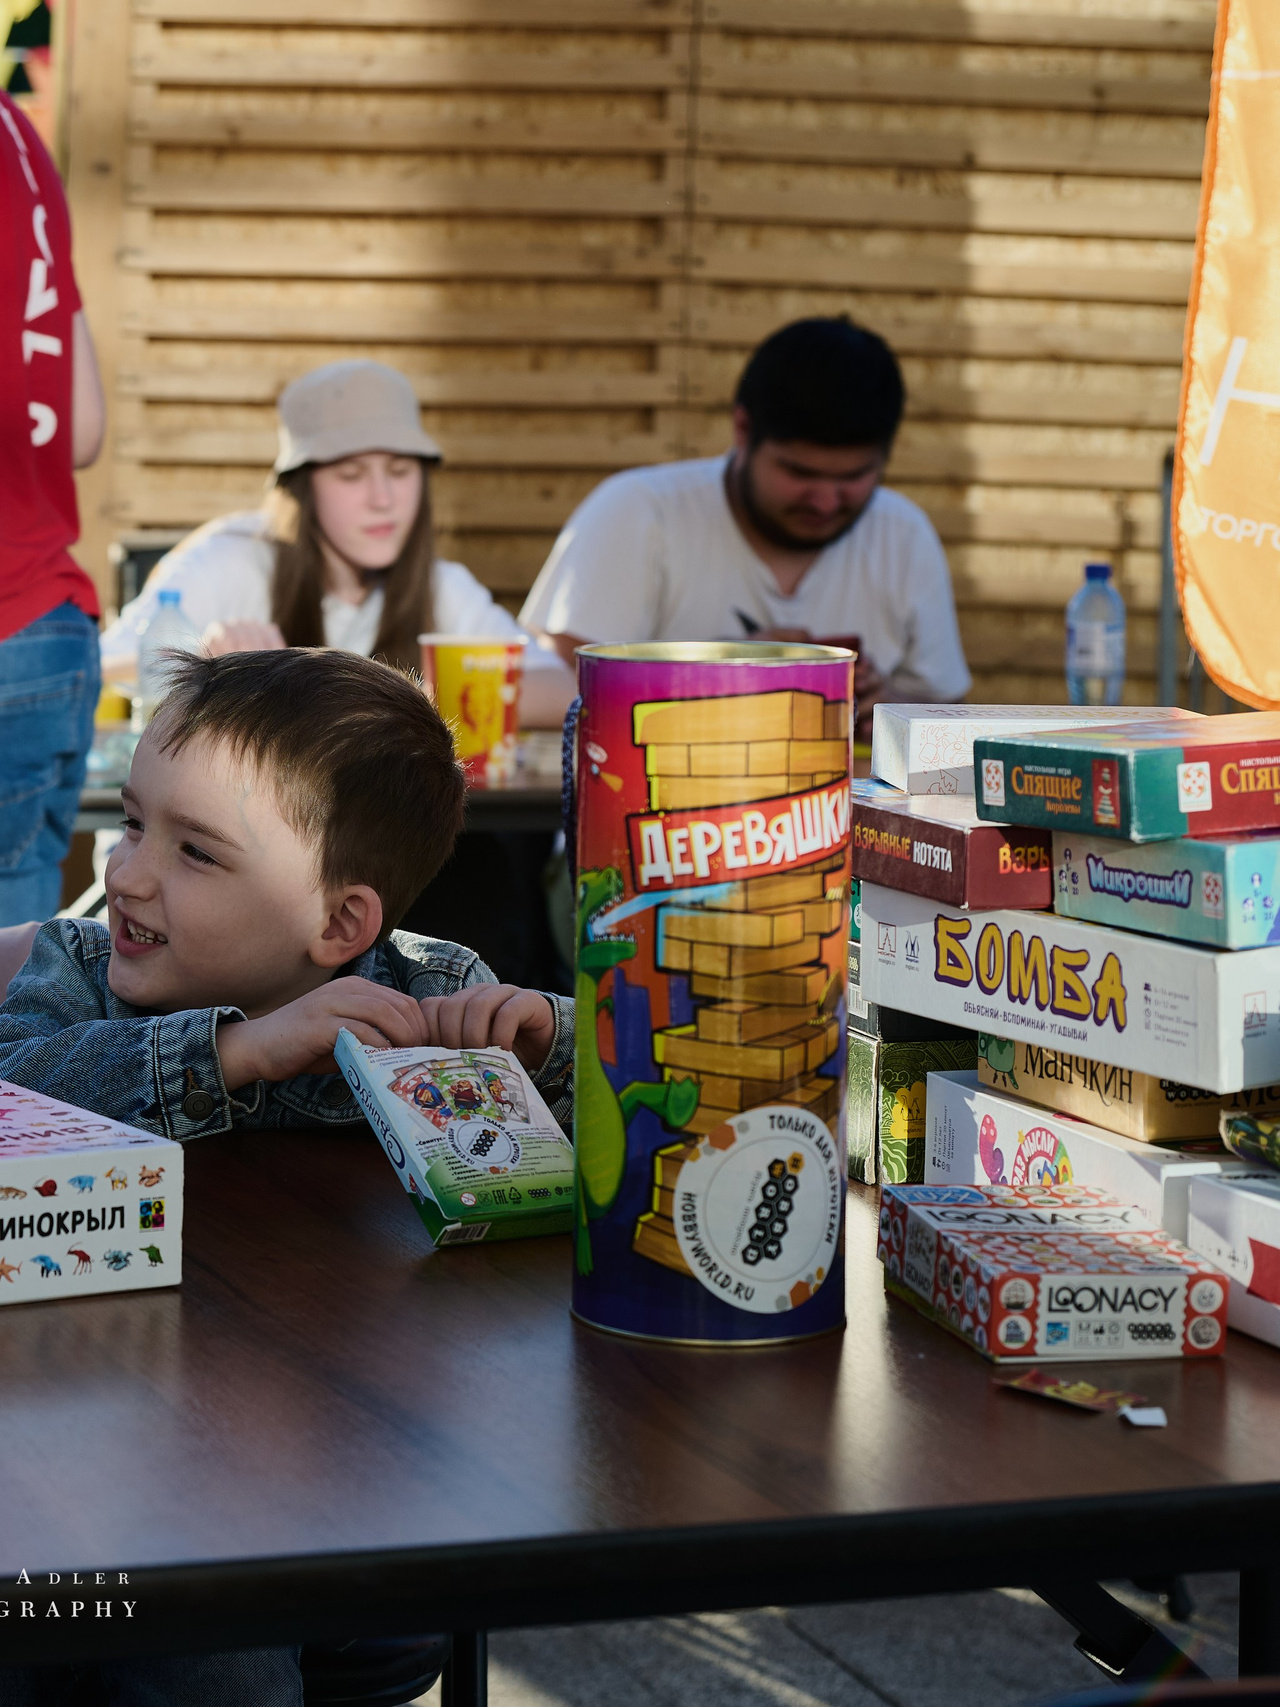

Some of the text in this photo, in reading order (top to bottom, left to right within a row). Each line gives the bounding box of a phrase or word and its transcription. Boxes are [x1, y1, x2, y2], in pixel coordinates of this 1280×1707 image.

[638, 784, 851, 887] ДЕРЕВЯШКИ
[854, 821, 953, 873] ВЗРЫВНЫЕ КОТЯТА
[934, 914, 1127, 1033] БОМБА
[1050, 1023, 1088, 1042] УГАДЫВАЙ
[769, 1114, 816, 1140] ТОЛЬКО
[814, 1134, 833, 1164] ДЛЯ
[1021, 1130, 1056, 1162] МЫСЛИ
[926, 1210, 1132, 1226] LOONACY
[681, 1190, 756, 1301] HOBBYWORLD.RU
[1047, 1286, 1179, 1313] LOONACY
